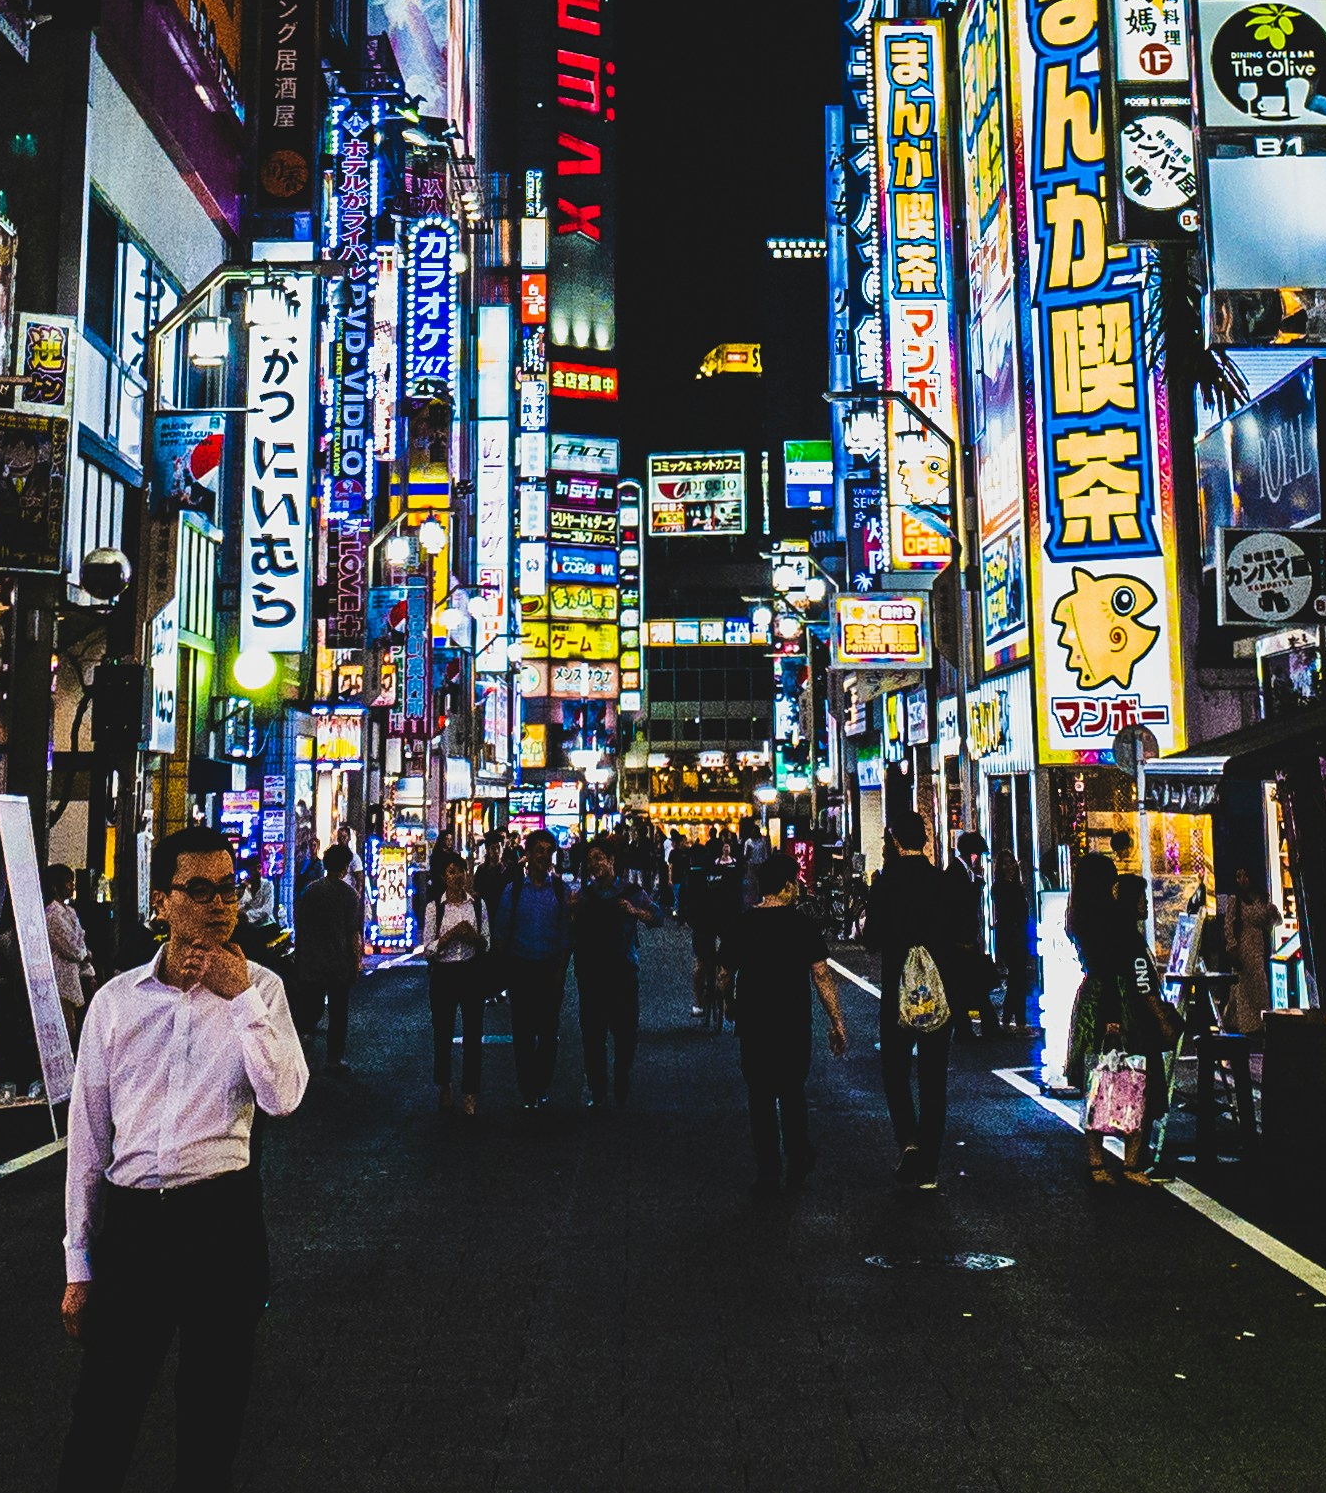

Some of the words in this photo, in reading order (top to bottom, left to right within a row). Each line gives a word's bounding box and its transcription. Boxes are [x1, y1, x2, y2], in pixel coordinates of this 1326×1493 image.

[1140, 50, 1171, 70] 1F
[1230, 51, 1263, 59] DINING
[1265, 51, 1286, 59] CAFE
[1296, 51, 1315, 59] BAR
[1230, 60, 1264, 78] The
[1266, 59, 1316, 78] Olive
[1255, 136, 1303, 156] B1
[887, 39, 937, 295] まんが喫茶
[416, 231, 448, 352] カラオケ
[551, 370, 616, 396] 全店営業中
[652, 458, 741, 473] コミック&ネットカフェ
[903, 535, 951, 556] OPEN
[551, 633, 594, 654] ゲーム
[845, 642, 886, 654] PRIVATE
[1054, 699, 1169, 733] マンボー
